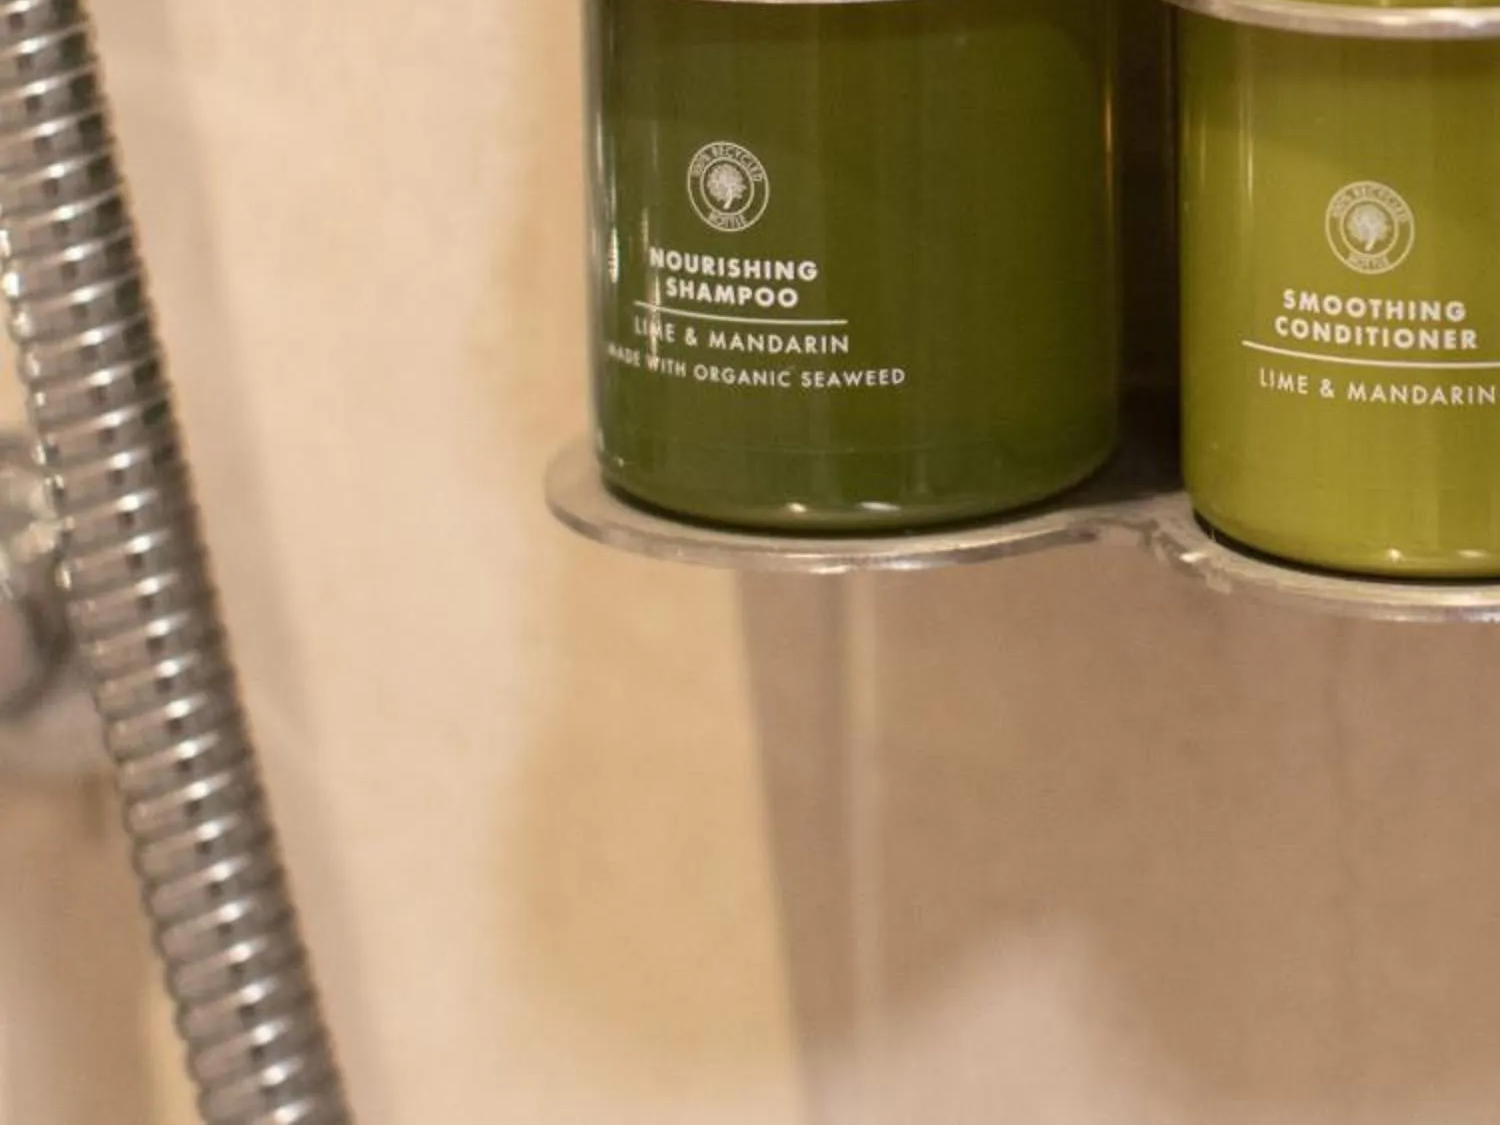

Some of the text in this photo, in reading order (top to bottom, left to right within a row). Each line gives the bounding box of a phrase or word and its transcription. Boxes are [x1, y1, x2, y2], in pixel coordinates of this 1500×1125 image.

[649, 246, 819, 282] NOURISHING
[665, 276, 799, 308] SHAMPOO
[1283, 288, 1467, 323] SMOOTHING
[634, 315, 849, 355] LIME & MANDARIN
[1274, 316, 1478, 351] CONDITIONER
[647, 355, 687, 378] WITH
[693, 364, 791, 388] ORGANIC
[801, 368, 905, 388] SEAWEED
[1260, 368, 1496, 405] LIME & MANDARIN
